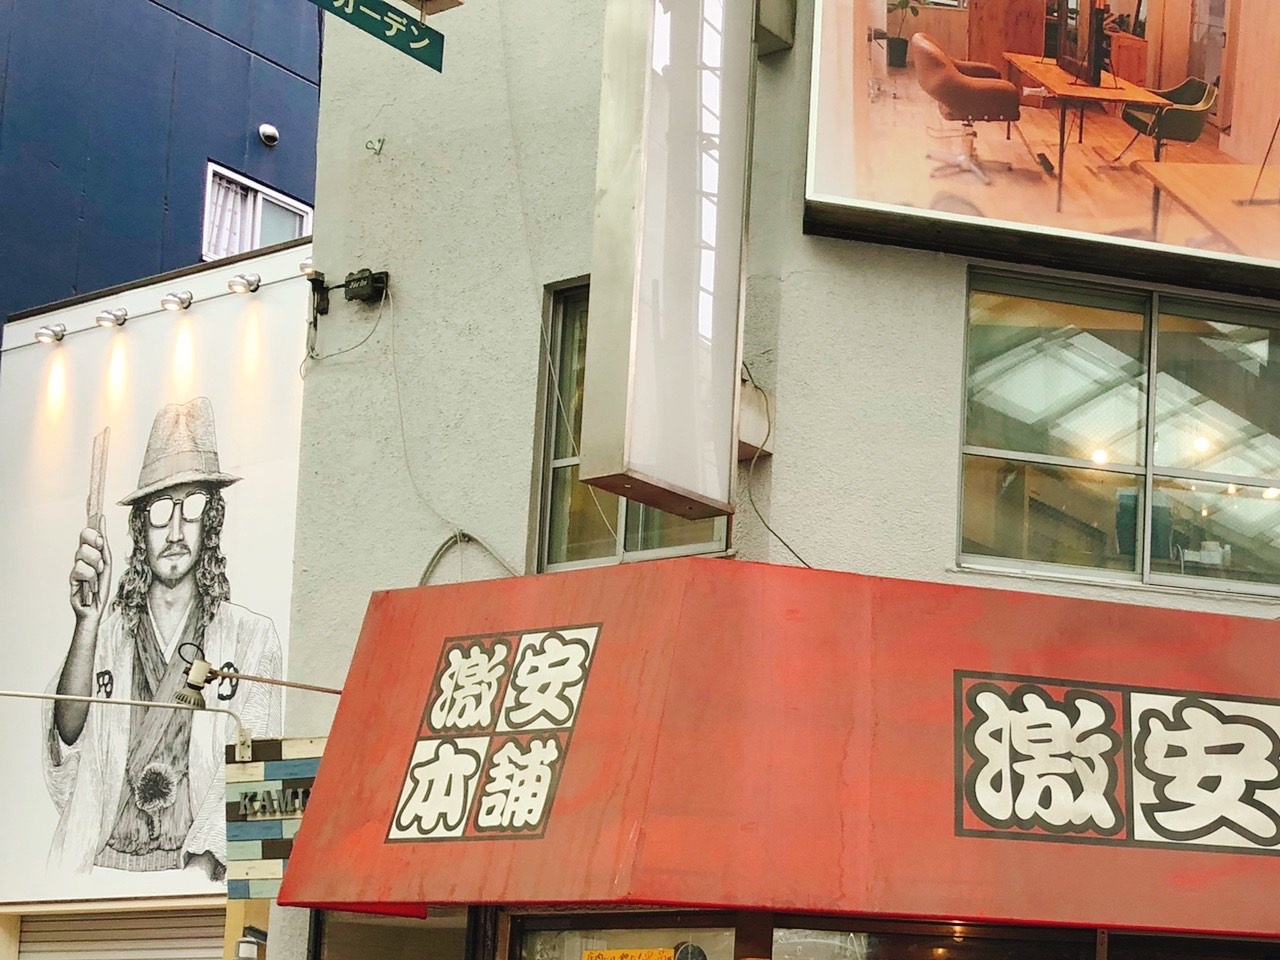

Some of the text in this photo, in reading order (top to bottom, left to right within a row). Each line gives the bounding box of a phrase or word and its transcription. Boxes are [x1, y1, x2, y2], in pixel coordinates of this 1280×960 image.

[429, 631, 590, 733] 激安
[238, 786, 313, 817] KAMI
[396, 737, 561, 834] 本舗
